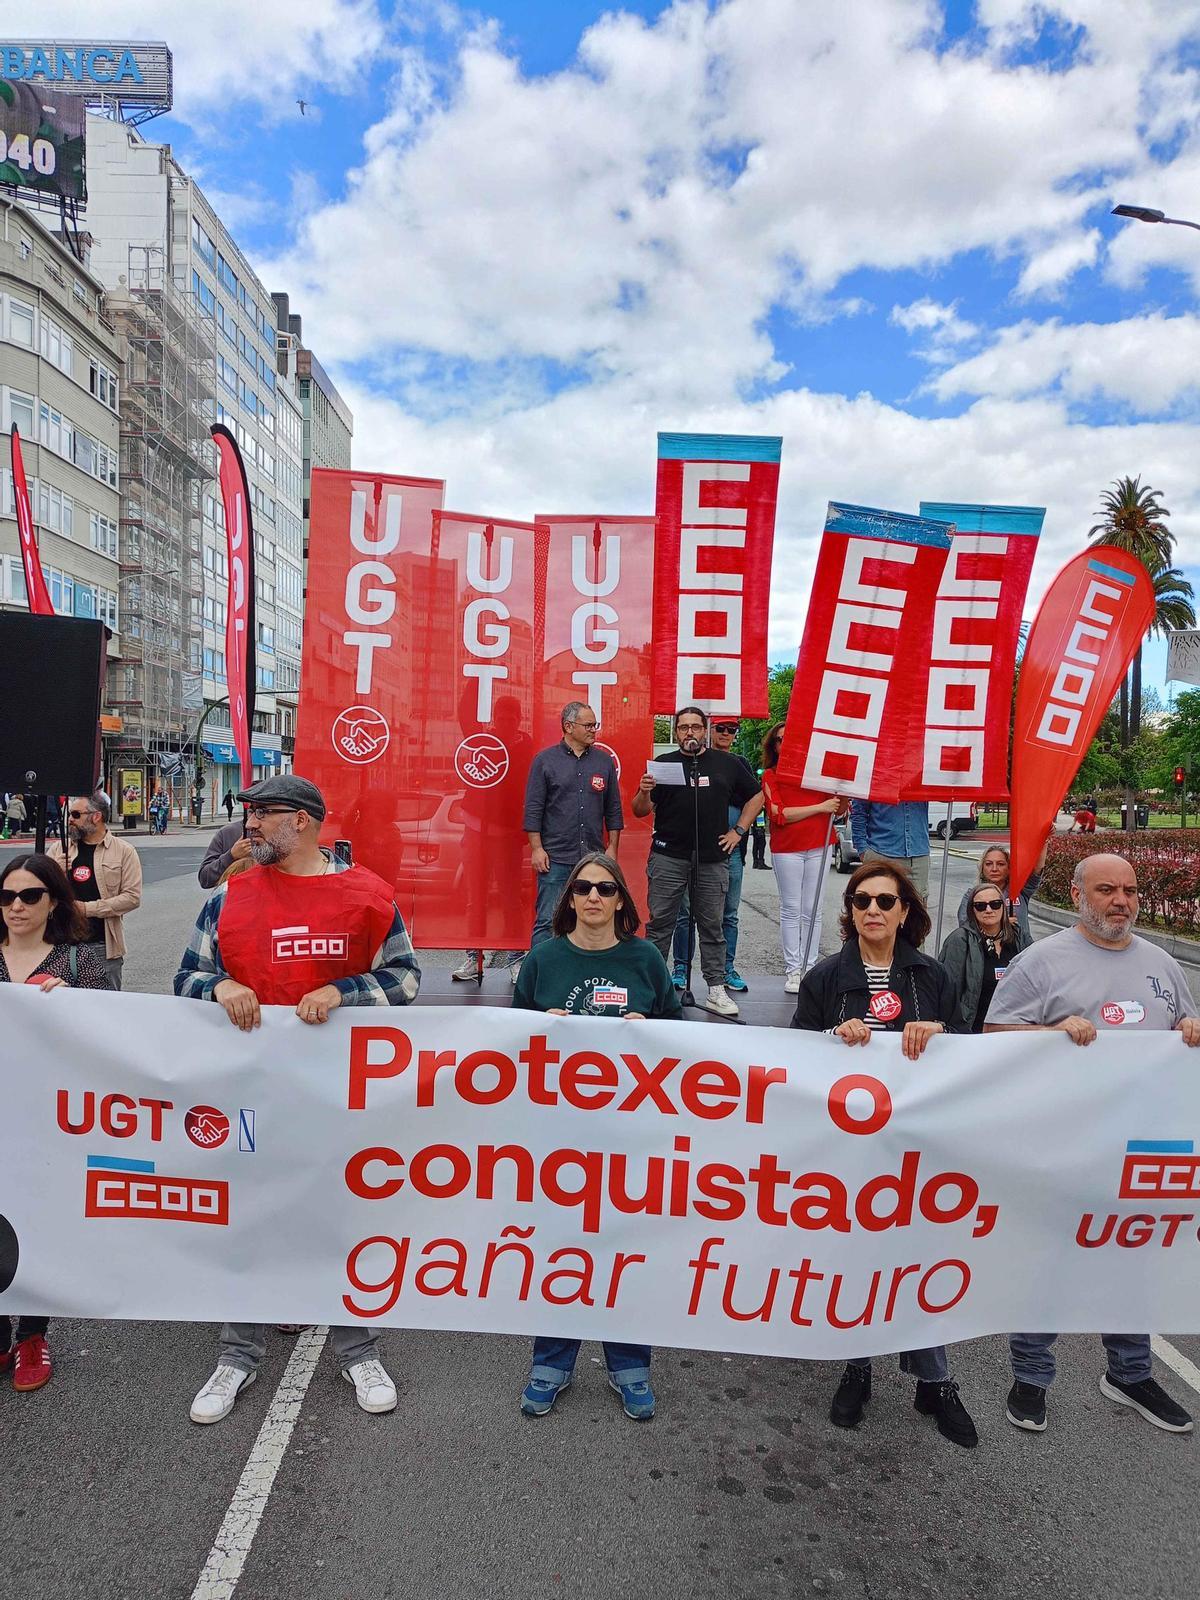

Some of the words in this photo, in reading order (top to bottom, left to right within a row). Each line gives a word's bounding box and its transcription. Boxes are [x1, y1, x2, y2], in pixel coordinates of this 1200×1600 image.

[1, 46, 144, 84] BANCA
[343, 490, 402, 695] UGT
[463, 532, 514, 723] UGT
[571, 535, 621, 730] UGT
[676, 463, 750, 716] CCOO
[801, 537, 918, 800] CCOO
[922, 535, 1009, 787] CCOO
[1036, 579, 1122, 747] CCOO
[276, 939, 344, 957] CCOO
[597, 993, 625, 1002] CCOO
[871, 992, 895, 1012] UGT
[57, 1089, 174, 1142] UGT
[347, 1025, 787, 1124] Protexer
[827, 1073, 893, 1135] o
[96, 1180, 219, 1215] CCOO
[345, 1135, 999, 1238] conquistado,
[1075, 1213, 1194, 1248] UGT
[342, 1224, 646, 1318] gañar
[687, 1236, 971, 1329] futuro
